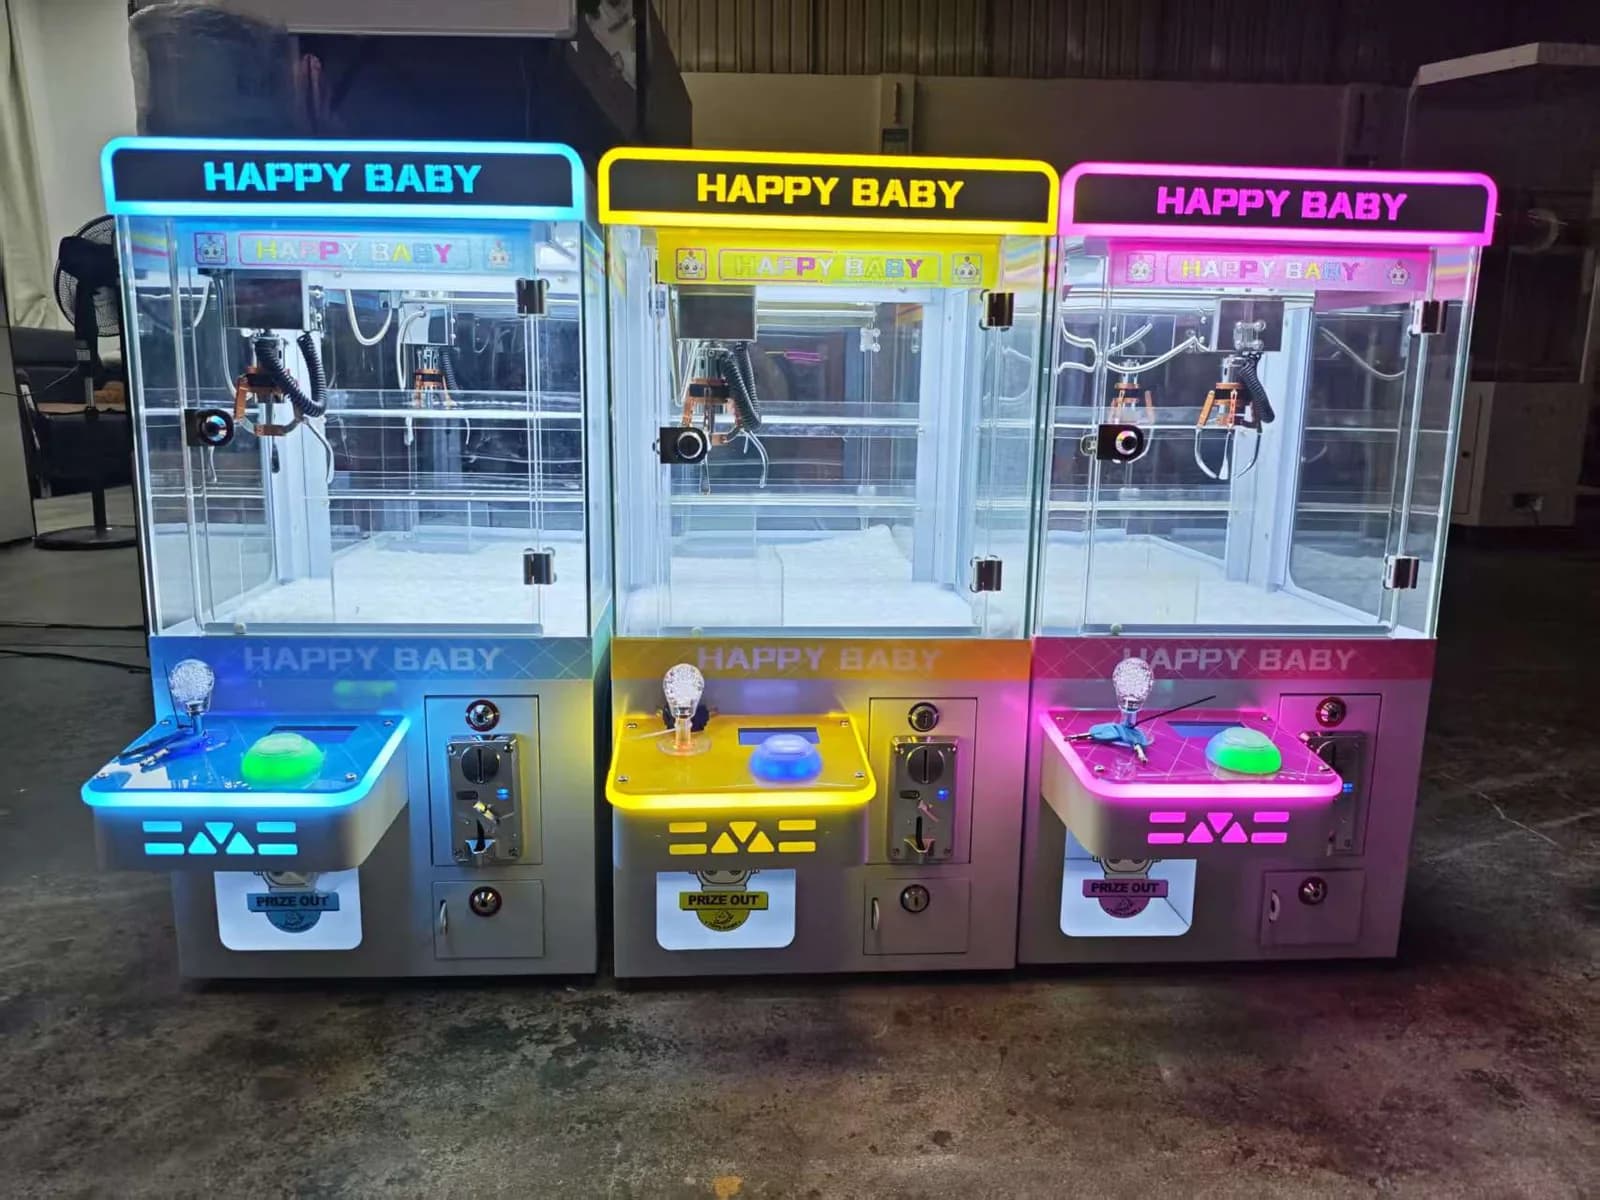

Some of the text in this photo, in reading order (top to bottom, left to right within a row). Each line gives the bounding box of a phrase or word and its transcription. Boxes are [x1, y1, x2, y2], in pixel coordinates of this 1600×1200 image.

[203, 161, 481, 194] HAPPY BABY
[698, 173, 965, 209] HAPPY BABY
[1157, 186, 1408, 221] HAPPY BABY
[256, 239, 452, 264] HAPPY BABY
[735, 256, 924, 279] HAPPY BABY
[1181, 260, 1361, 281] HAPPY BABY
[243, 647, 503, 672] HAPPY BABY
[699, 647, 944, 672] HAPPY BABY
[1258, 648, 1357, 672] BABY
[1091, 882, 1160, 893] PRIZE OUT
[256, 895, 329, 907] PRIZE OUT
[688, 895, 759, 905] PRIZE OUT
